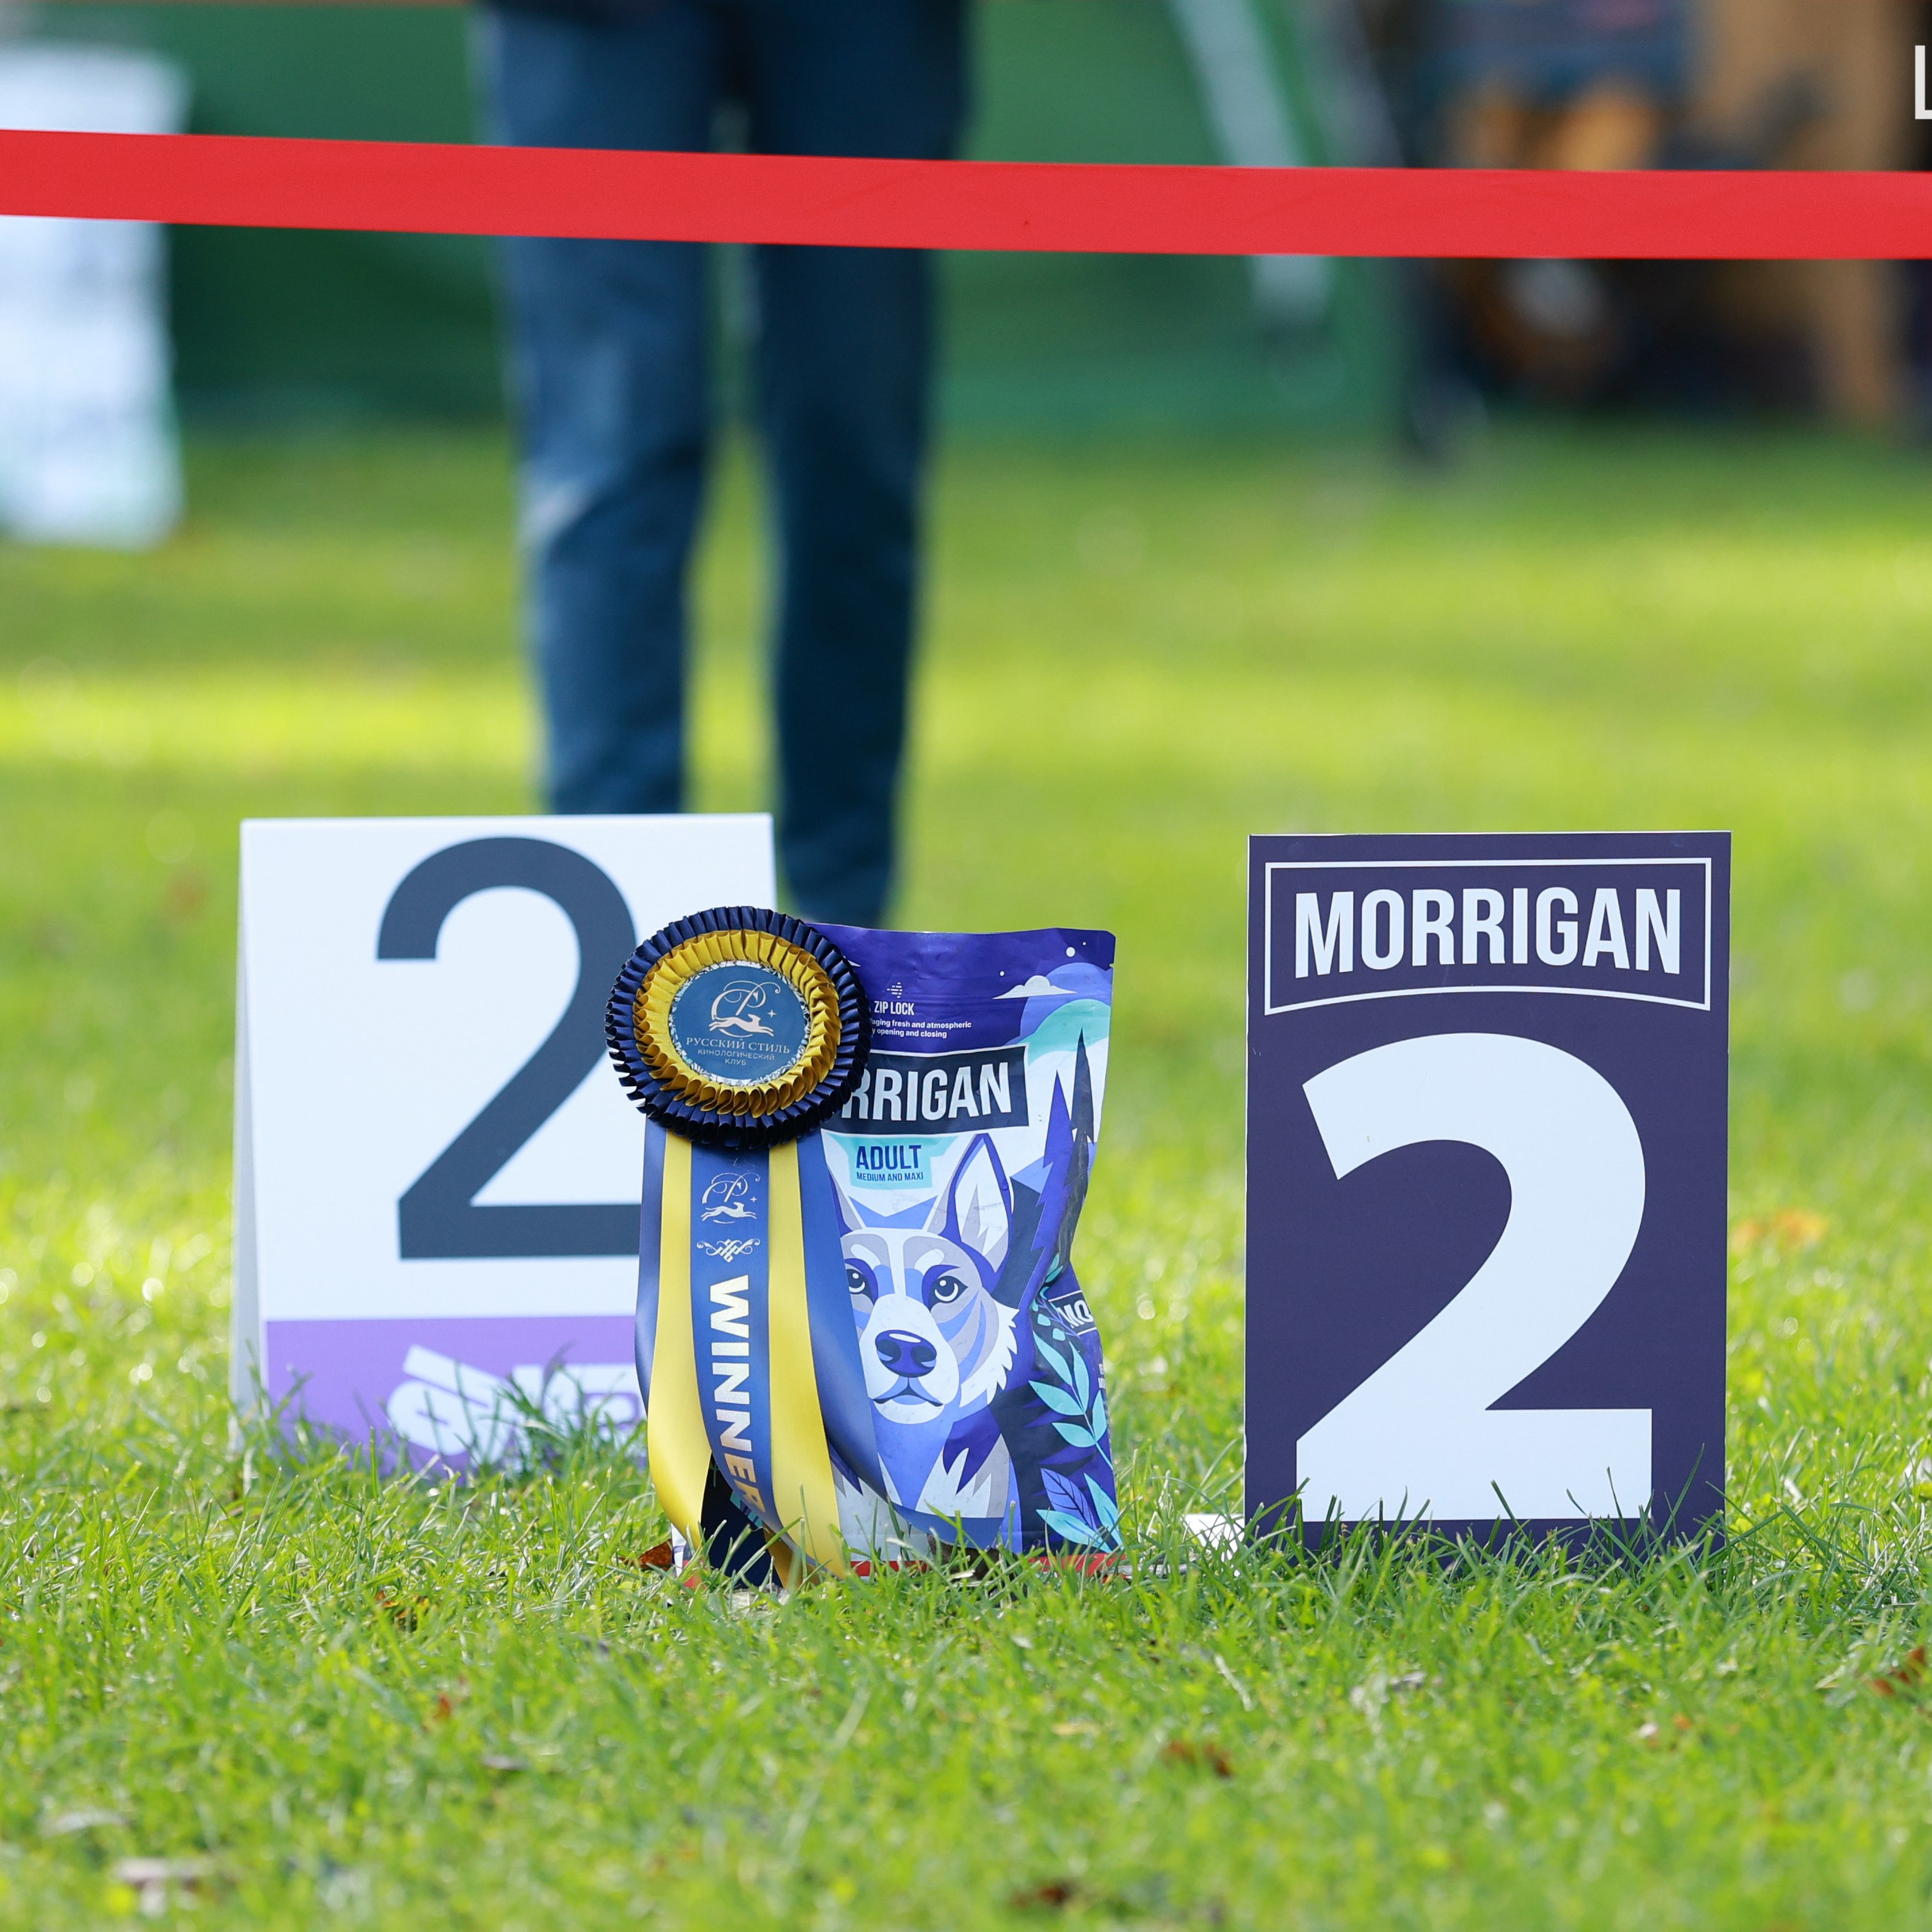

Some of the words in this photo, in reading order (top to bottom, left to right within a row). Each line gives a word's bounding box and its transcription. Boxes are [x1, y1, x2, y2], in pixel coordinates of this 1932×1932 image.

[1295, 887, 1681, 979] MORRIGAN
[874, 1001, 888, 1014] ZIP
[891, 1001, 915, 1016] LOCK
[870, 1018, 892, 1027] aging
[892, 1020, 910, 1028] fresh
[926, 1021, 972, 1030] atmospheric
[877, 1028, 904, 1038] opening
[920, 1030, 947, 1038] closing
[377, 835, 643, 1260] 2
[686, 1037, 745, 1050] РУССКИЙ
[748, 1041, 791, 1054] СТИЛЬ
[697, 1048, 775, 1061] КИНОЛОГИЧЕСКИЙ
[724, 1058, 747, 1066] КЛУБ
[841, 1062, 1012, 1121] RRIGAN
[856, 1145, 922, 1171] ADULT
[857, 1171, 885, 1182] MEDIUM
[887, 1173, 903, 1182] AND
[904, 1171, 924, 1181] MAXI
[1296, 1032, 1653, 1522] 2
[709, 1274, 766, 1513] WINNER
